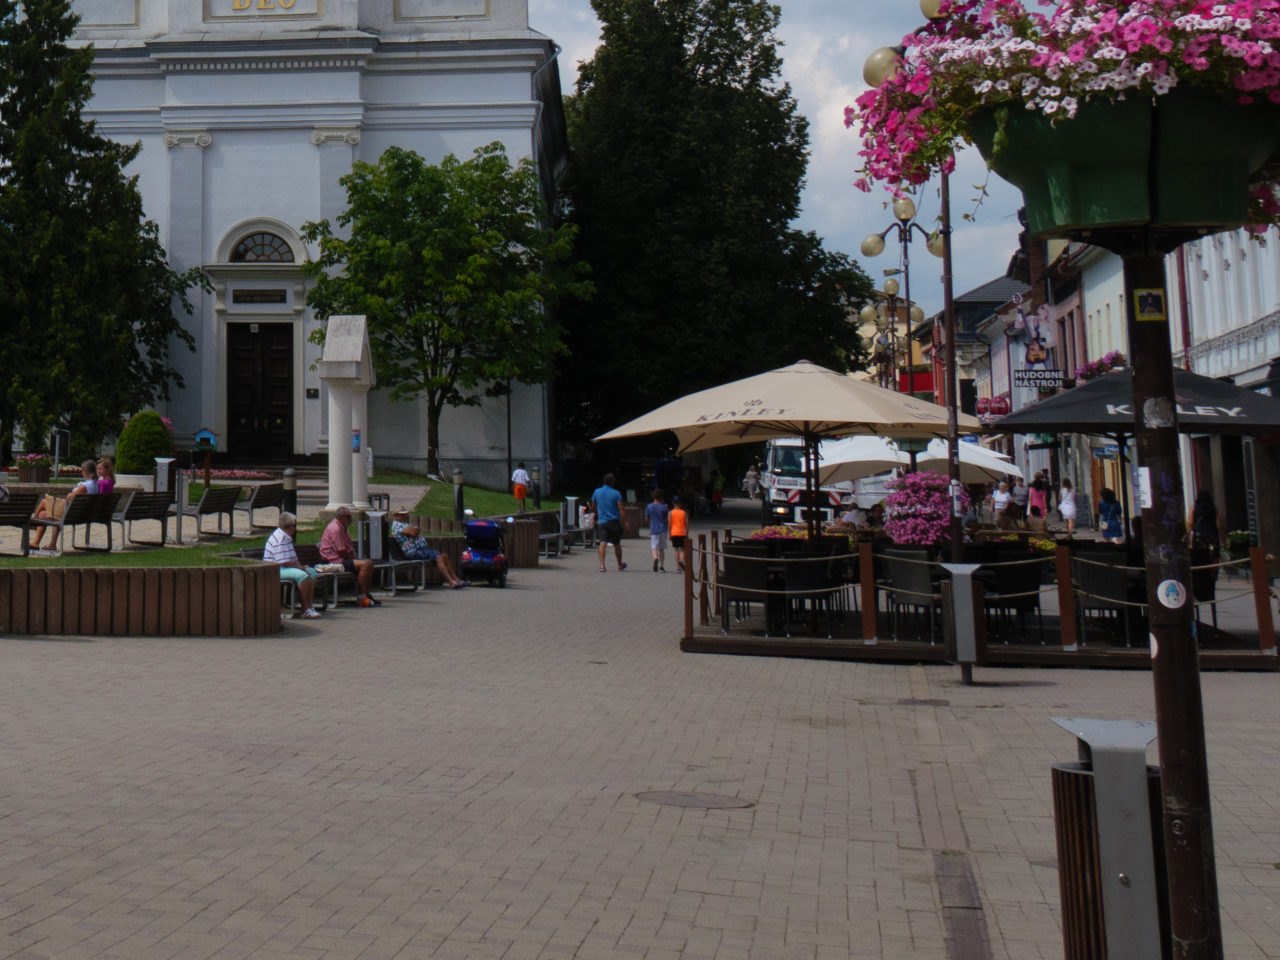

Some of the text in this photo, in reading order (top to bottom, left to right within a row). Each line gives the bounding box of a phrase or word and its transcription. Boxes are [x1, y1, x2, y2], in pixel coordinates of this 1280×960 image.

[1015, 370, 1064, 379] HUDOBNÉ
[696, 408, 794, 423] KINLEY
[1105, 403, 1243, 417] KLEY
